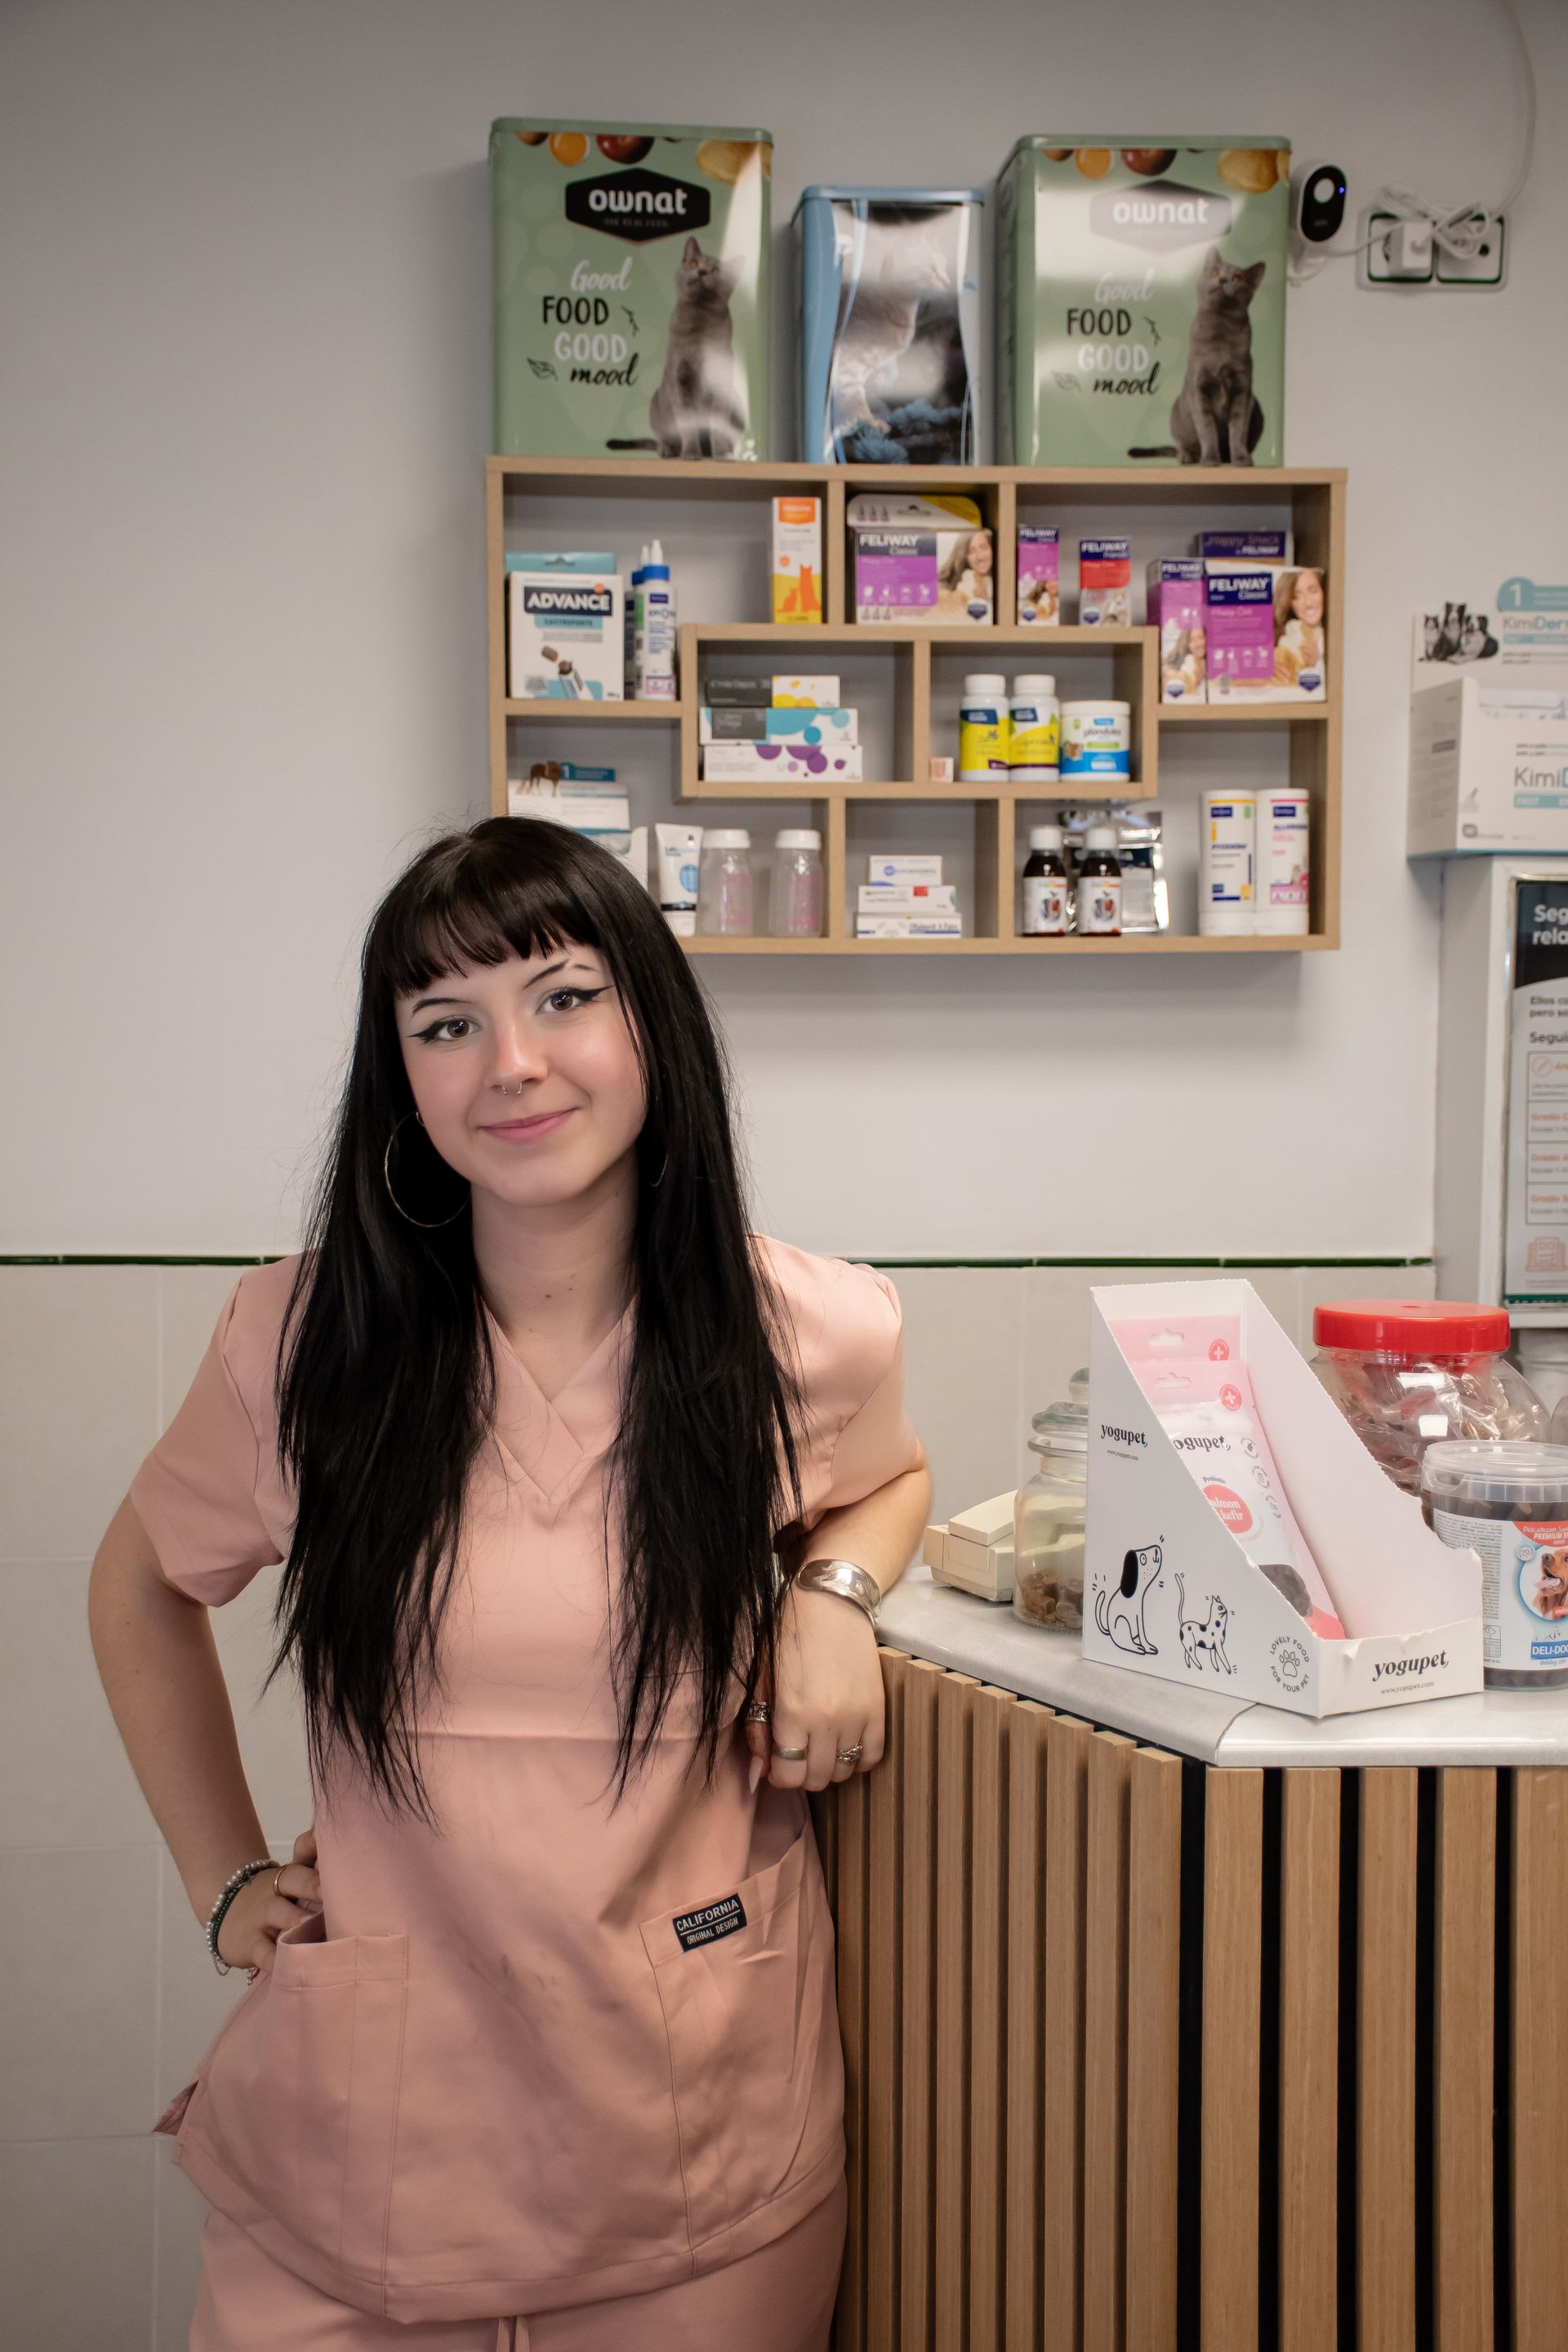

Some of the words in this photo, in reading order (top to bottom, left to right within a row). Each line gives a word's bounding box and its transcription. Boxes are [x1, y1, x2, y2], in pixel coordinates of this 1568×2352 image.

[589, 188, 688, 215] ownat
[1113, 198, 1209, 225] ownat
[572, 257, 633, 292] Good
[1094, 267, 1156, 303] Good
[542, 296, 609, 325] FOOD
[1067, 308, 1132, 336] FOOD
[554, 332, 627, 363] GOOD
[1078, 343, 1150, 372] GOOD
[570, 353, 639, 386] mood
[1093, 361, 1161, 395] mood
[860, 533, 919, 547] FELIWAY
[1209, 577, 1268, 592] FELIWAY
[528, 591, 610, 612] ADVANCE
[1101, 1424, 1147, 1447] yogupet
[1173, 1435, 1230, 1453] ogupet
[1534, 1532, 1563, 1540] PREMIUM
[1270, 1636, 1290, 1655] LOVELY
[1293, 1639, 1309, 1663] FOOD
[1270, 1665, 1281, 1684] FOR
[1282, 1682, 1301, 1693] YOUR
[1300, 1673, 1310, 1689] PET
[1372, 1650, 1449, 1682] yogupet
[1381, 1682, 1435, 1695] www.yogupet.com
[676, 1899, 739, 1931] CALIFORNIA
[687, 1928, 715, 1944] ORIGINAL
[715, 1916, 739, 1935] DESIGN
